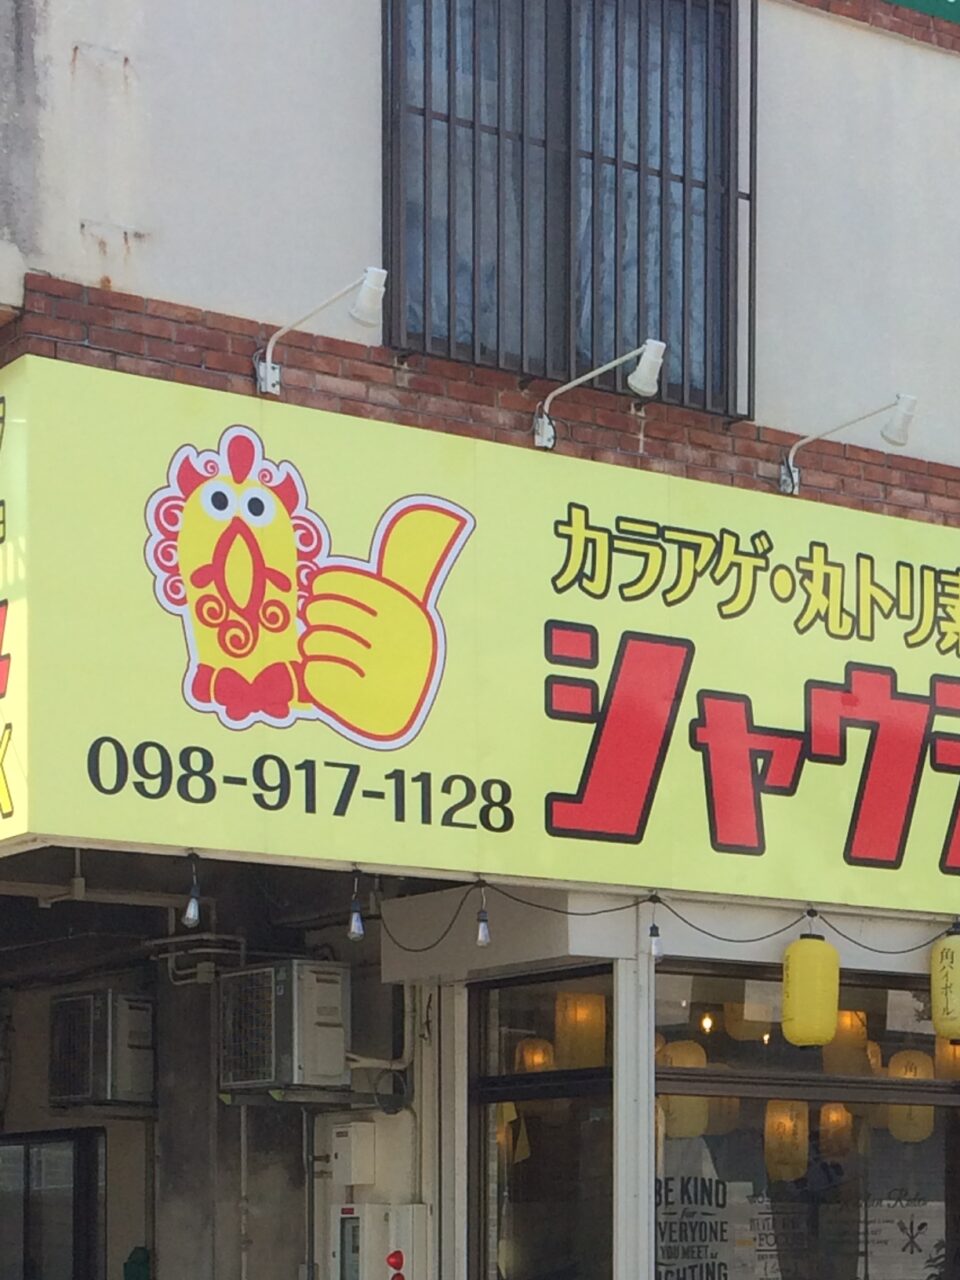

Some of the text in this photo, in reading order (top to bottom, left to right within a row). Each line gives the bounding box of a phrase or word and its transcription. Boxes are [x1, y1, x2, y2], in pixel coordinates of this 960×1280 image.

[86, 736, 515, 834] 098-917-1128
[680, 1176, 727, 1209] KIND
[658, 1220, 728, 1243] VERYONE
